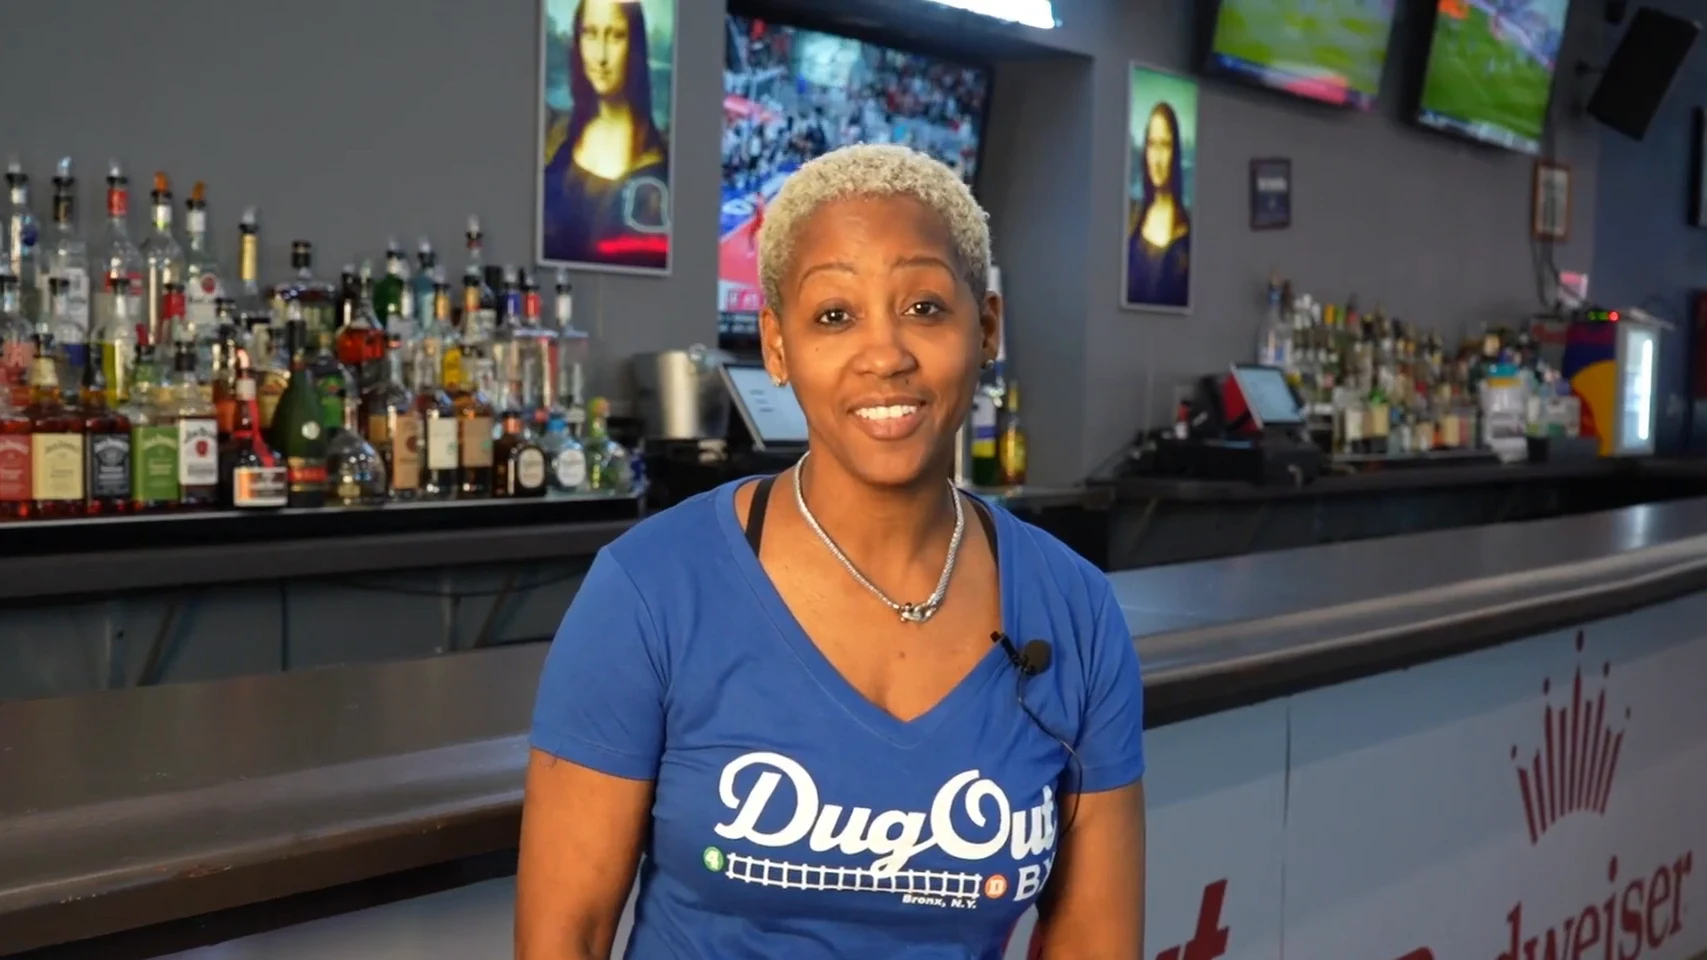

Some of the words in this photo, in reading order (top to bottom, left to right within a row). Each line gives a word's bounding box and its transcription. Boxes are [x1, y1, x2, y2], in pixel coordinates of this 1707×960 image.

[714, 752, 1057, 874] DugOut
[902, 894, 946, 908] Bronx,
[951, 898, 977, 909] N.Y.
